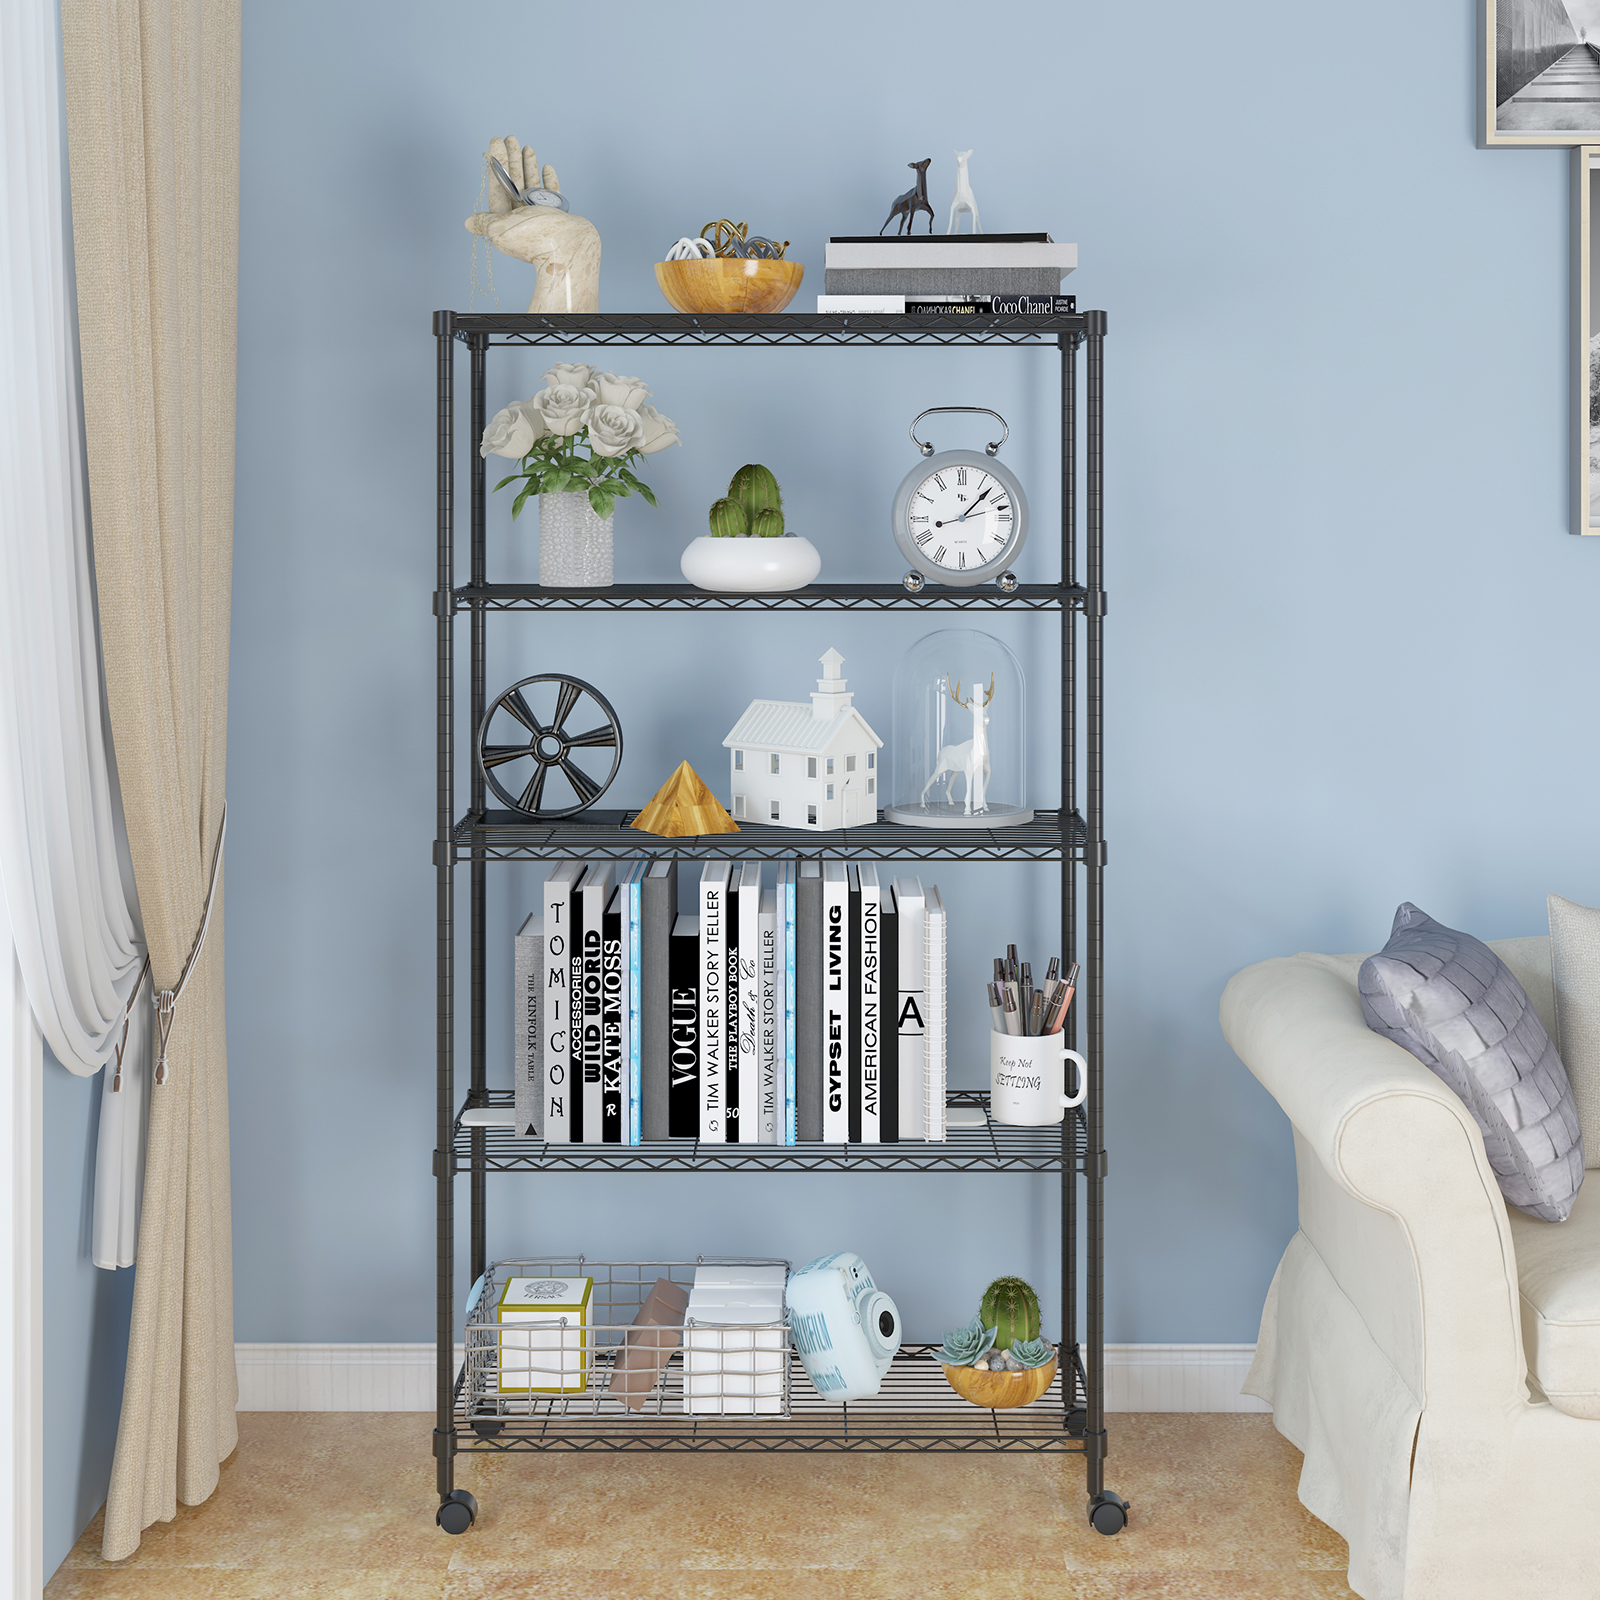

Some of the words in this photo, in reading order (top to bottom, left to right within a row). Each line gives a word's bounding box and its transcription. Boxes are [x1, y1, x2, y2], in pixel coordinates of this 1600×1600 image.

[992, 295, 1018, 314] Coco
[1018, 295, 1053, 314] Chanel
[707, 890, 719, 944] TELLER
[584, 930, 601, 1016] WORLD
[604, 939, 621, 1014] MOSS
[707, 950, 719, 1003] STORY
[728, 947, 738, 982] BOOK
[763, 930, 774, 975] TELLER
[829, 905, 842, 991] LIVING
[864, 903, 877, 994] FASHION
[528, 995, 537, 1051] KINFOLK
[572, 956, 582, 1061] ACCESSORIES
[728, 985, 738, 1043] PLAYBOY
[763, 980, 774, 1025] STORY
[898, 996, 925, 1028] A
[584, 1024, 601, 1083] WILD
[604, 1022, 621, 1094] KATE
[671, 988, 697, 1088] VOGUE
[707, 1008, 719, 1077] WALKER
[728, 1046, 738, 1071] THE
[763, 1029, 774, 1087] WALKER
[829, 1010, 842, 1112] GYPSET
[864, 1003, 877, 1116] AMERICAN
[707, 1083, 719, 1111] TIM
[726, 1107, 739, 1118] 50
[763, 1092, 774, 1115] TIM
